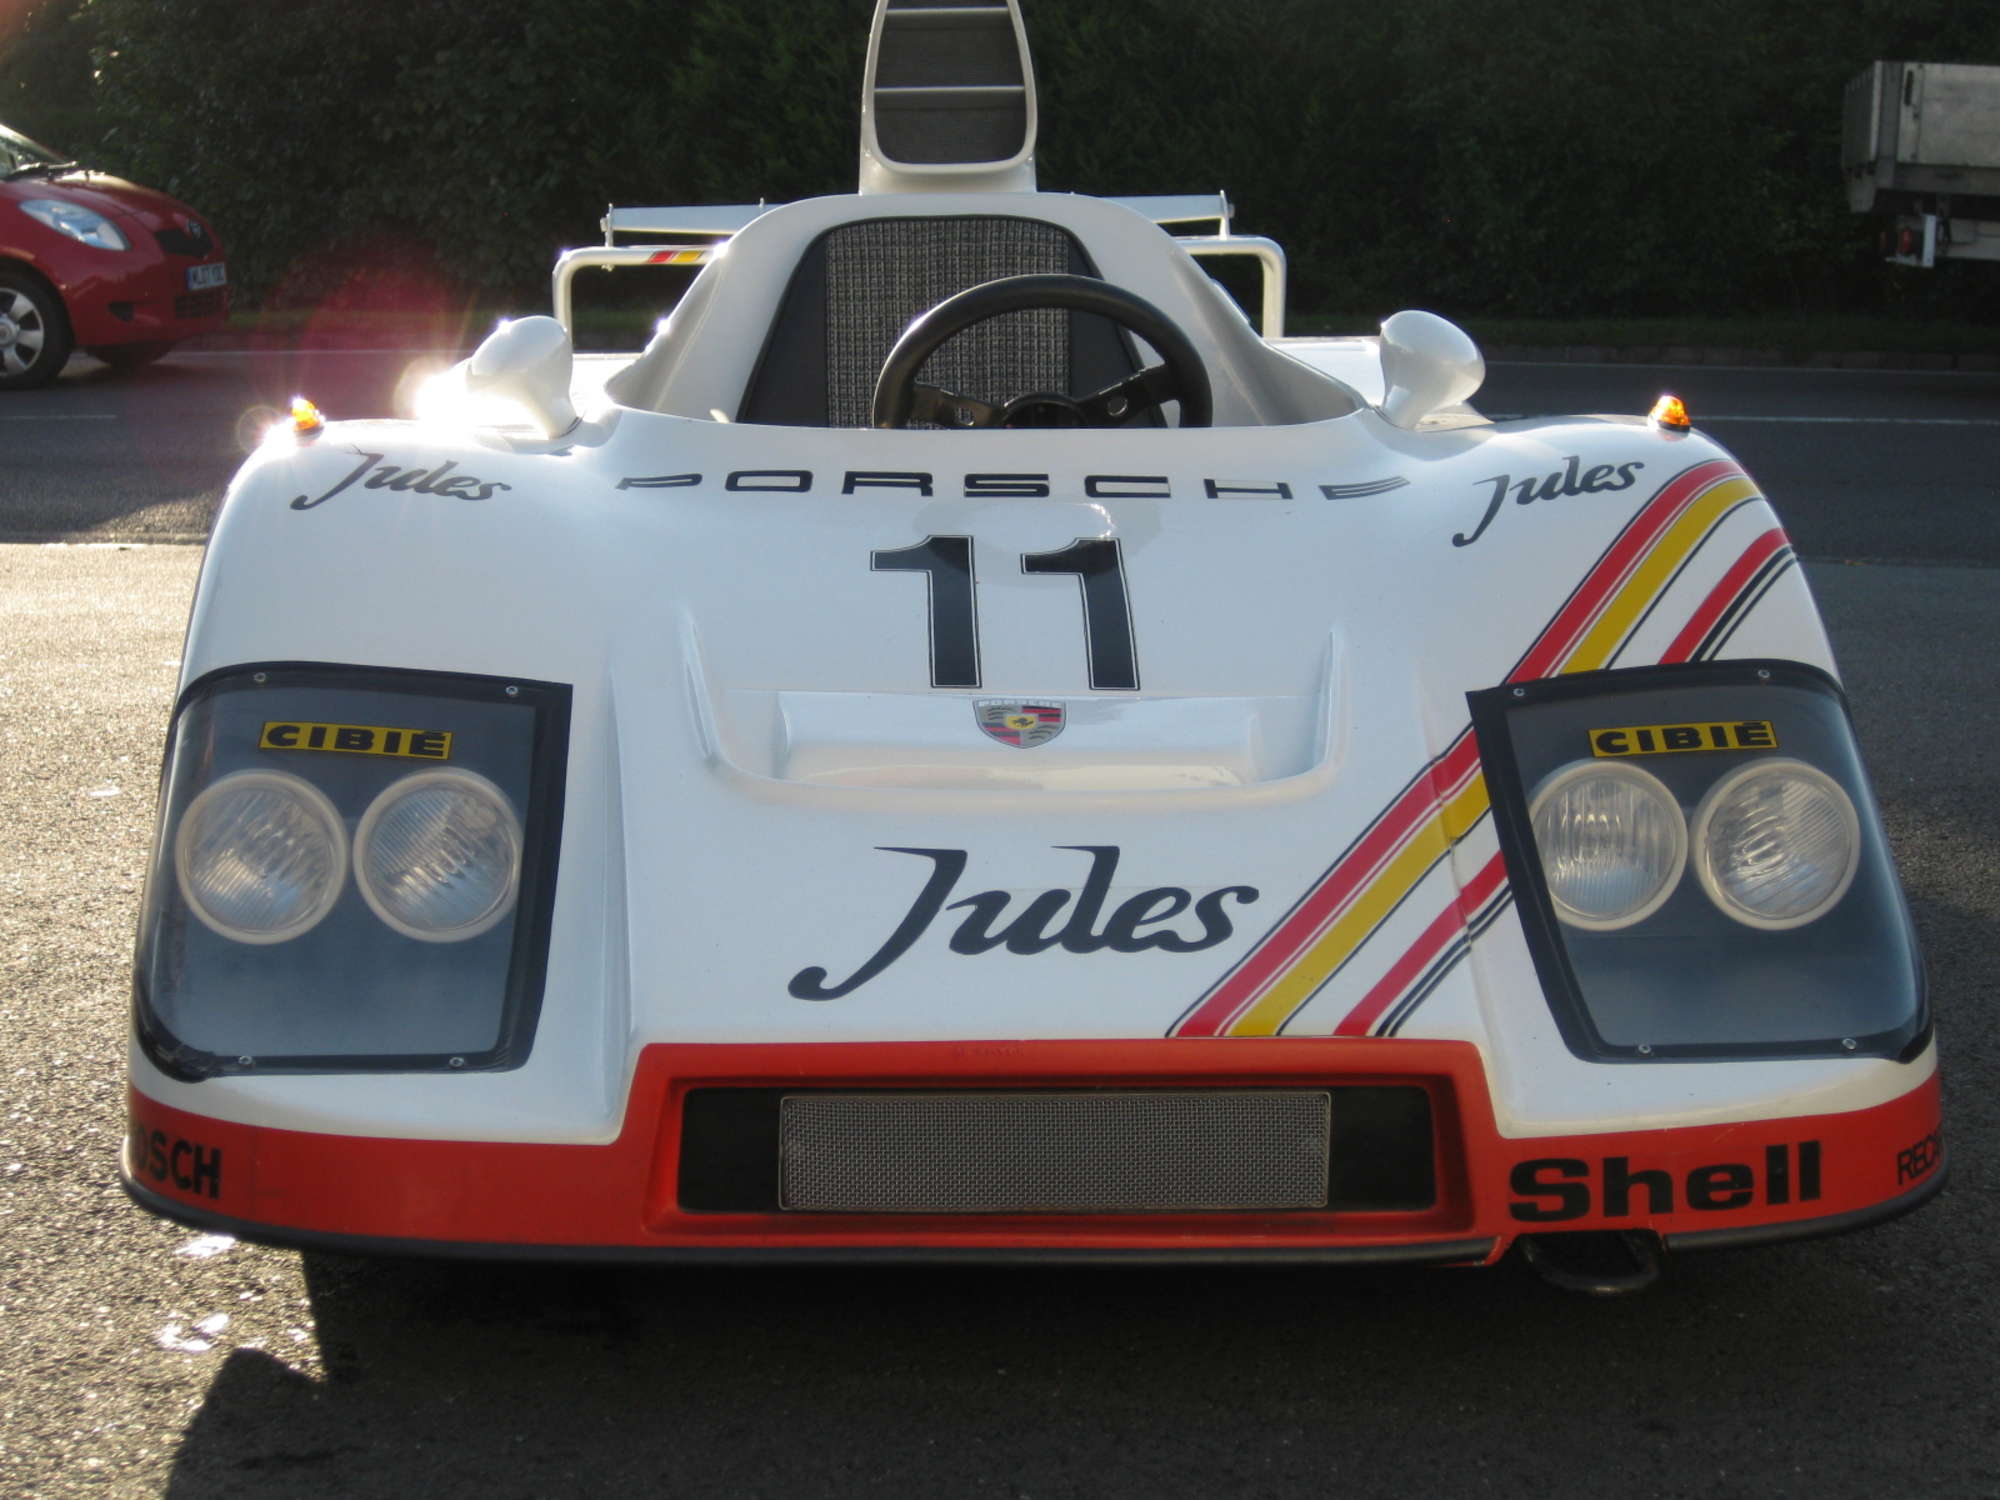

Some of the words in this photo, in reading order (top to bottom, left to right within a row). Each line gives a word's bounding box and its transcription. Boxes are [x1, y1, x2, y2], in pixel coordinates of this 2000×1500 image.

[290, 447, 512, 510] Jules
[615, 469, 1409, 500] PORSCHE
[1452, 455, 1645, 547] Jules
[869, 534, 1140, 690] 11
[788, 845, 1260, 1001] Jules
[1509, 1140, 1821, 1223] Shell
